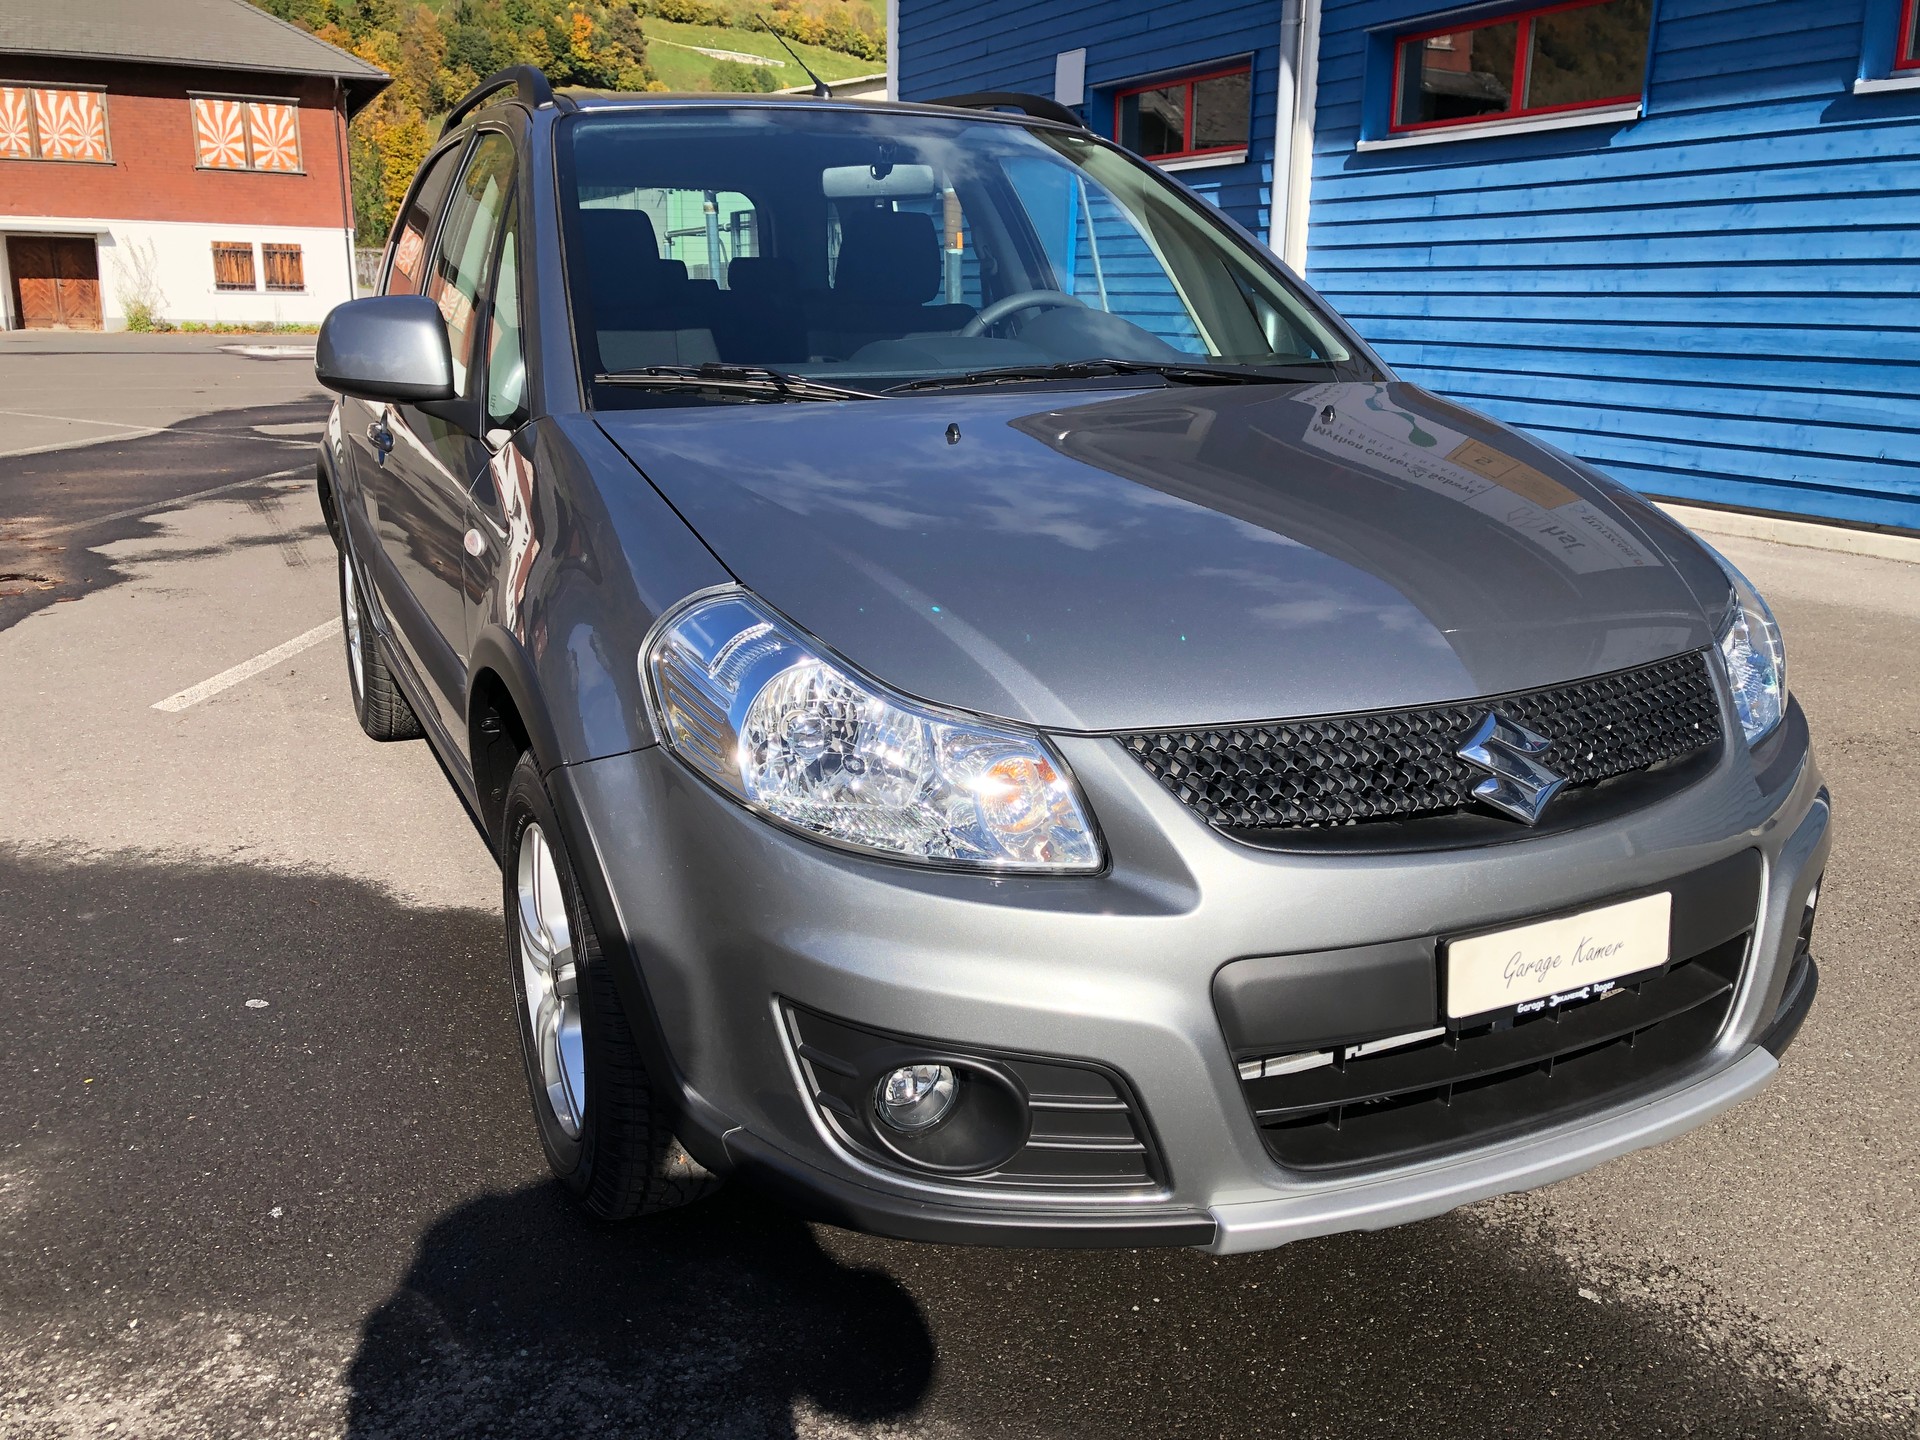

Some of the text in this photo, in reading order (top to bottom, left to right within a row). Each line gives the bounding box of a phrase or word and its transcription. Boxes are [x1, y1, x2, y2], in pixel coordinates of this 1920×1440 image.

[1503, 936, 1625, 989] Garage Kamer
[1517, 1000, 1545, 1013] Garage
[1593, 981, 1615, 993] Roger
